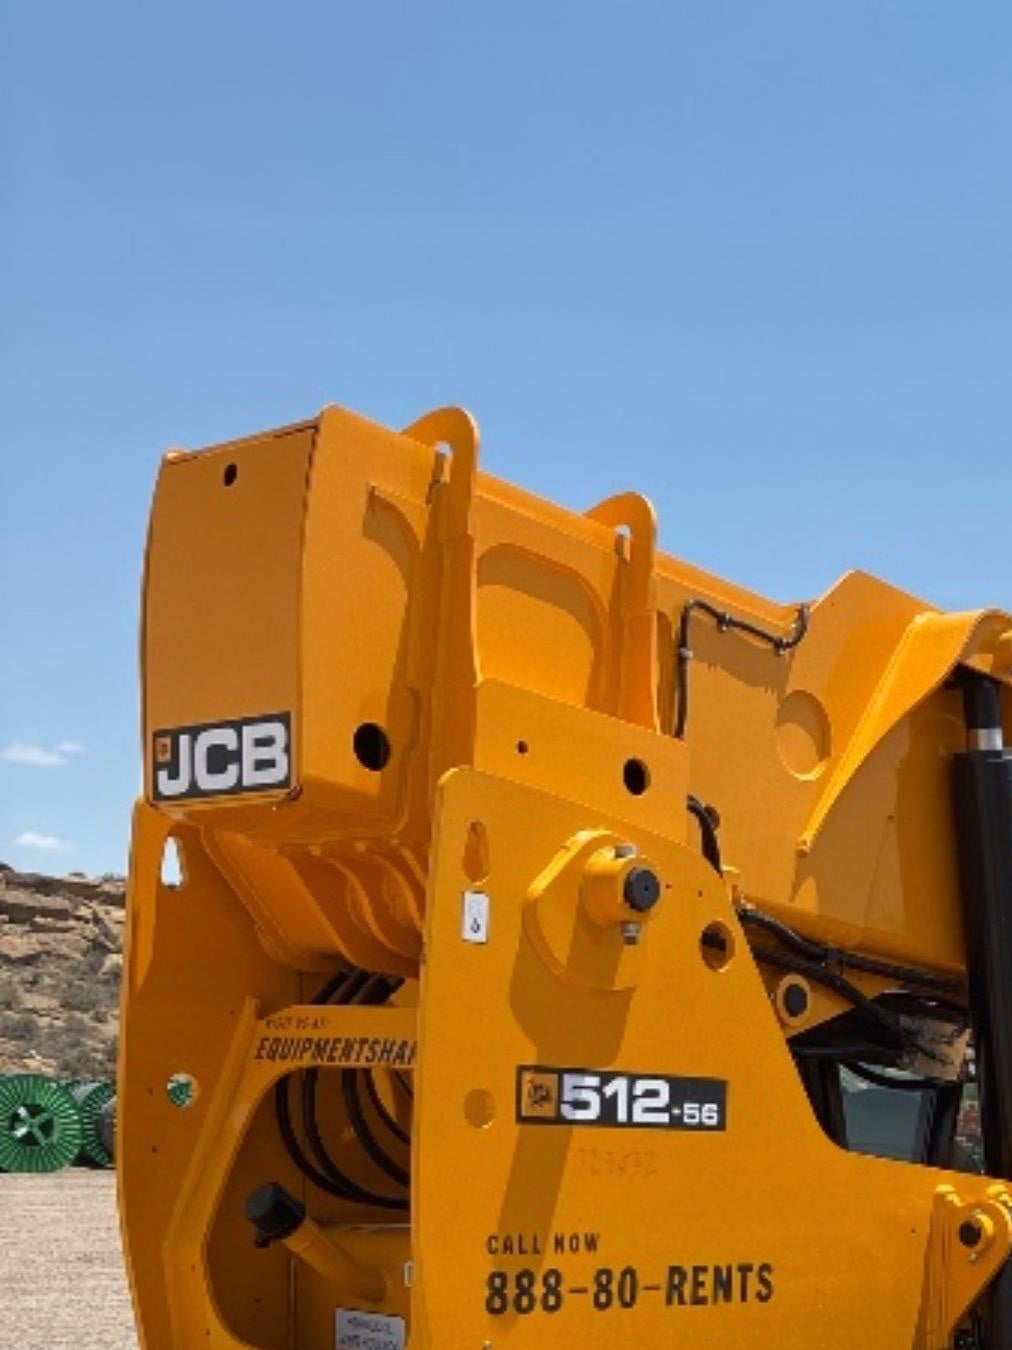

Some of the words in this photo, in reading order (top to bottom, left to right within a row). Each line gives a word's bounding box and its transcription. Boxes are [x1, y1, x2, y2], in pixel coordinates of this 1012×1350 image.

[157, 722, 289, 796] JCB
[486, 1234, 541, 1255] CALL
[554, 1232, 601, 1254] NOW
[485, 1262, 774, 1316] 888-80-RENTS
